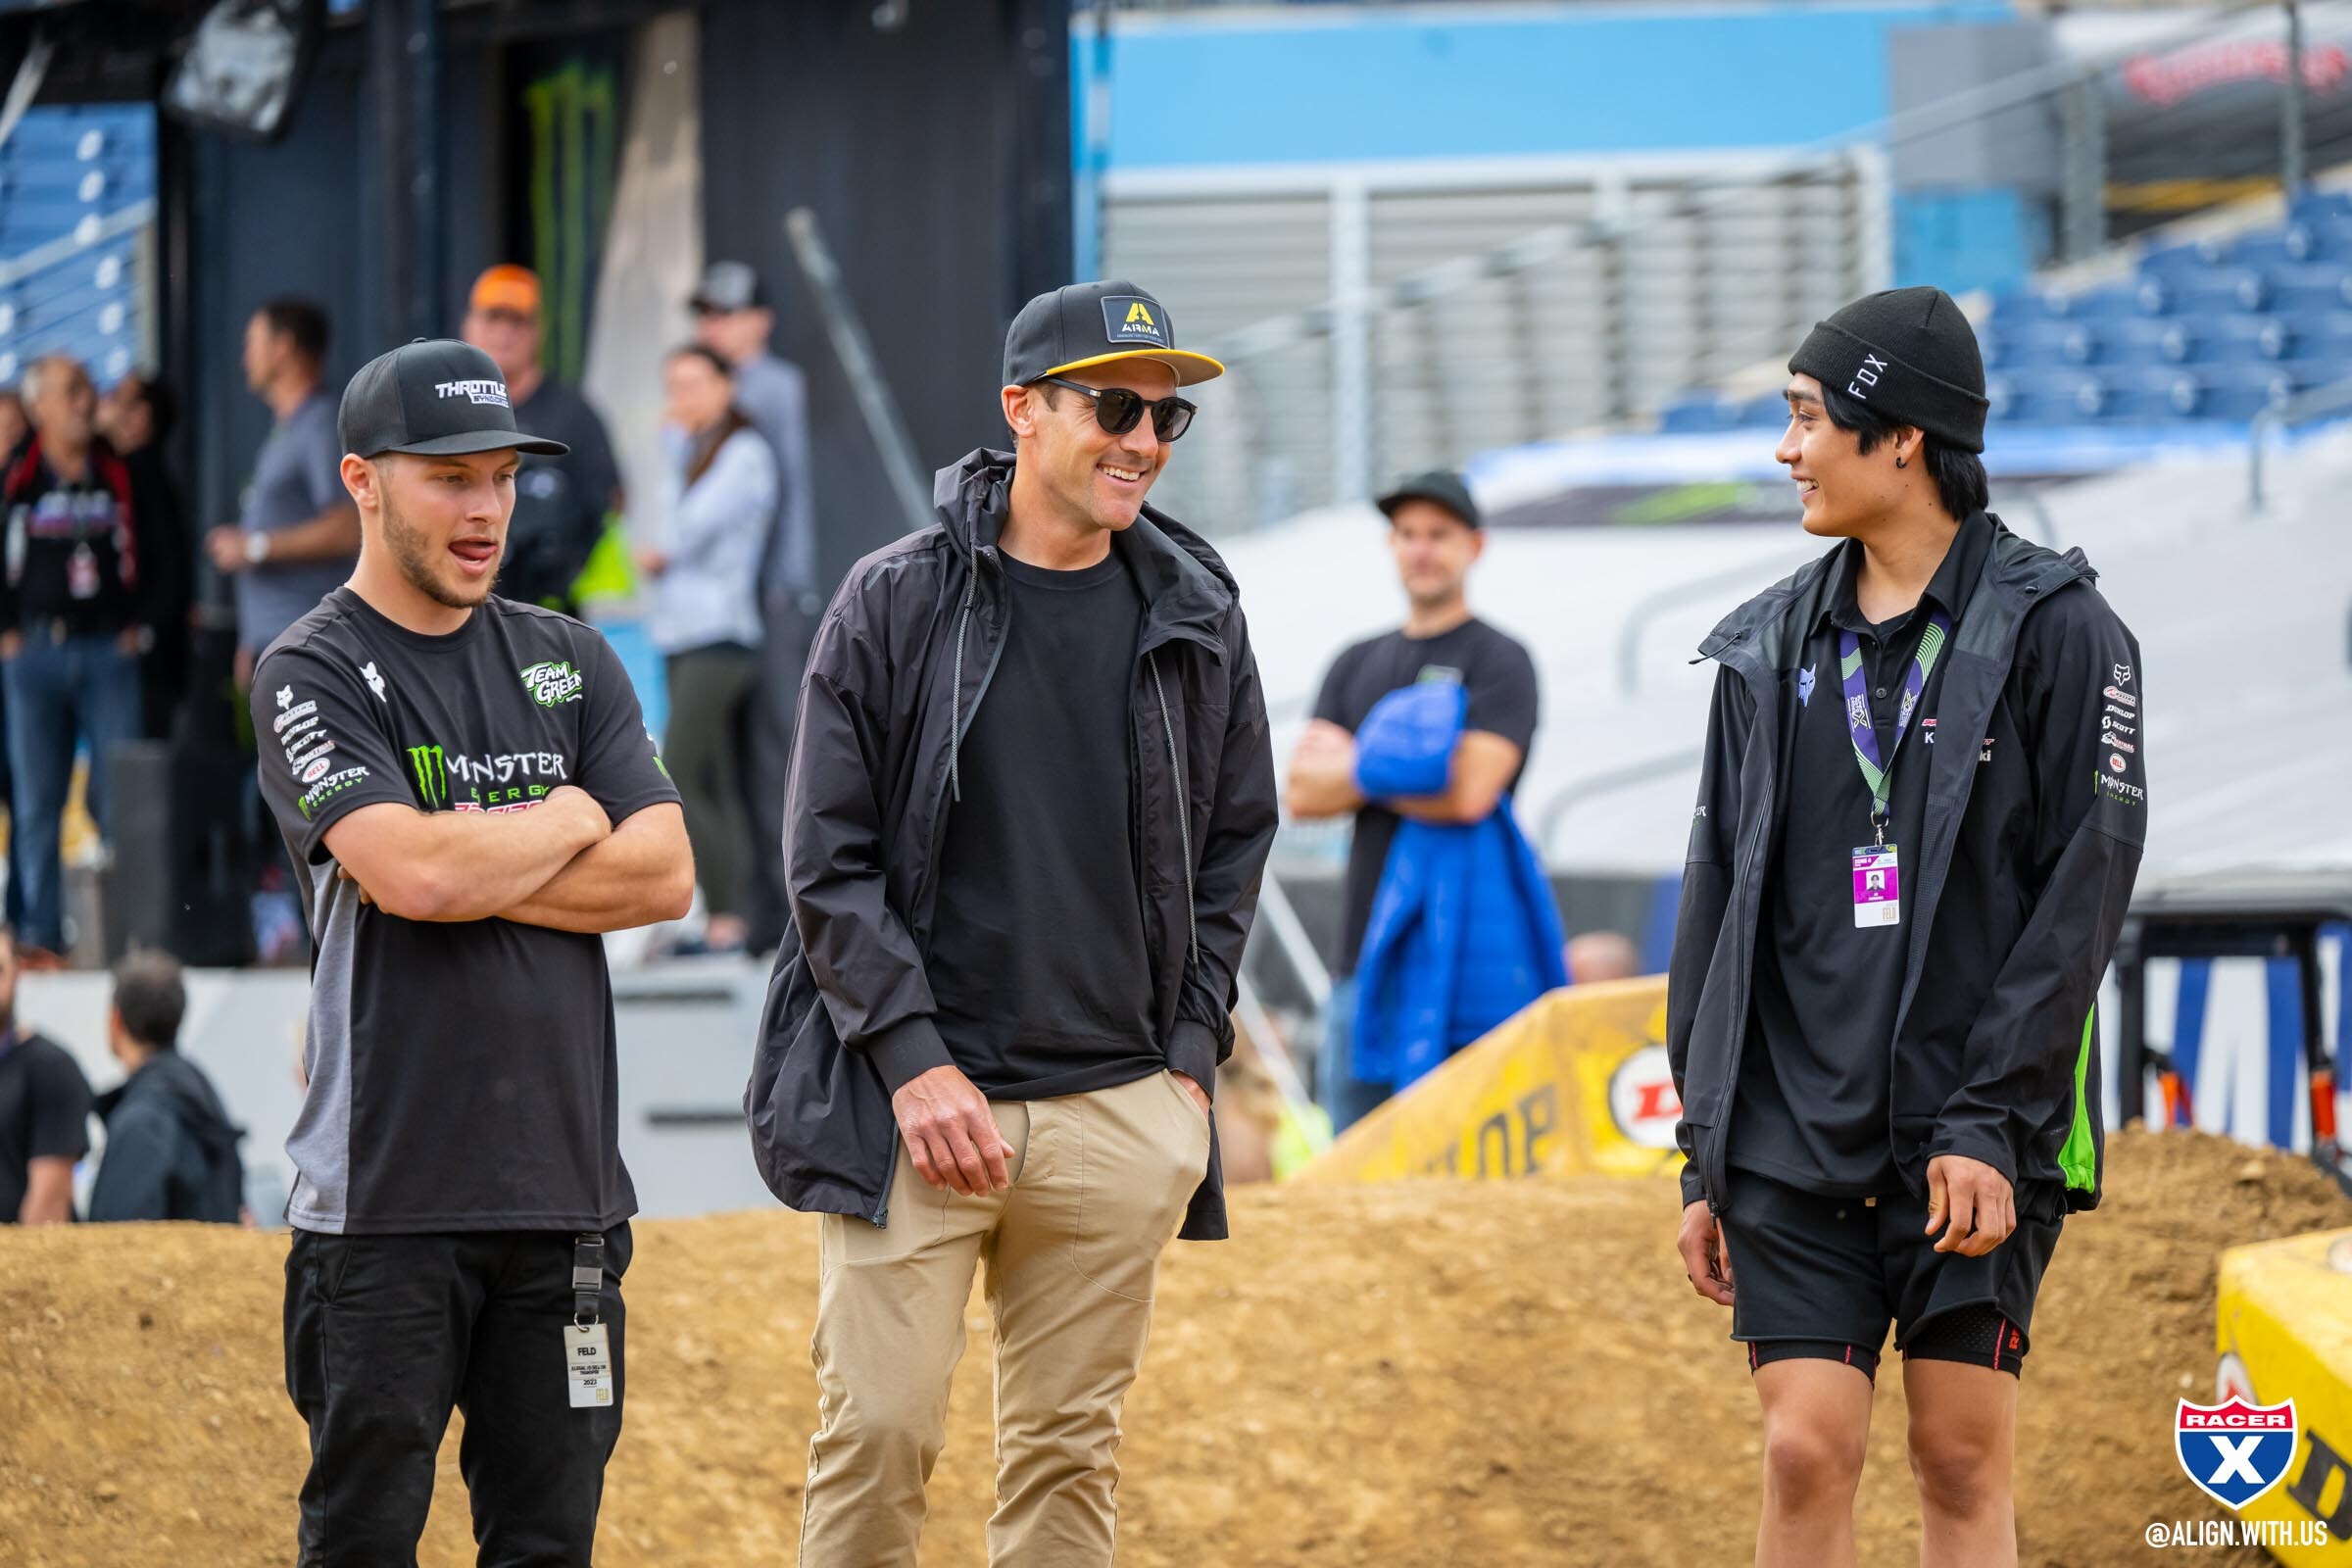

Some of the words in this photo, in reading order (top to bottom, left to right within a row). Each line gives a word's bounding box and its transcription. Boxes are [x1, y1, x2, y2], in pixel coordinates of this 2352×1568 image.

[1121, 323, 1160, 336] ARMA
[1847, 353, 1888, 399] FOX
[434, 379, 507, 398] THROTTLE
[520, 663, 568, 688] TEAM
[2112, 720, 2136, 734] SCOTT
[304, 765, 370, 804] MONSTER
[2100, 774, 2144, 801] MONSTER
[577, 1348, 597, 1356] FELD
